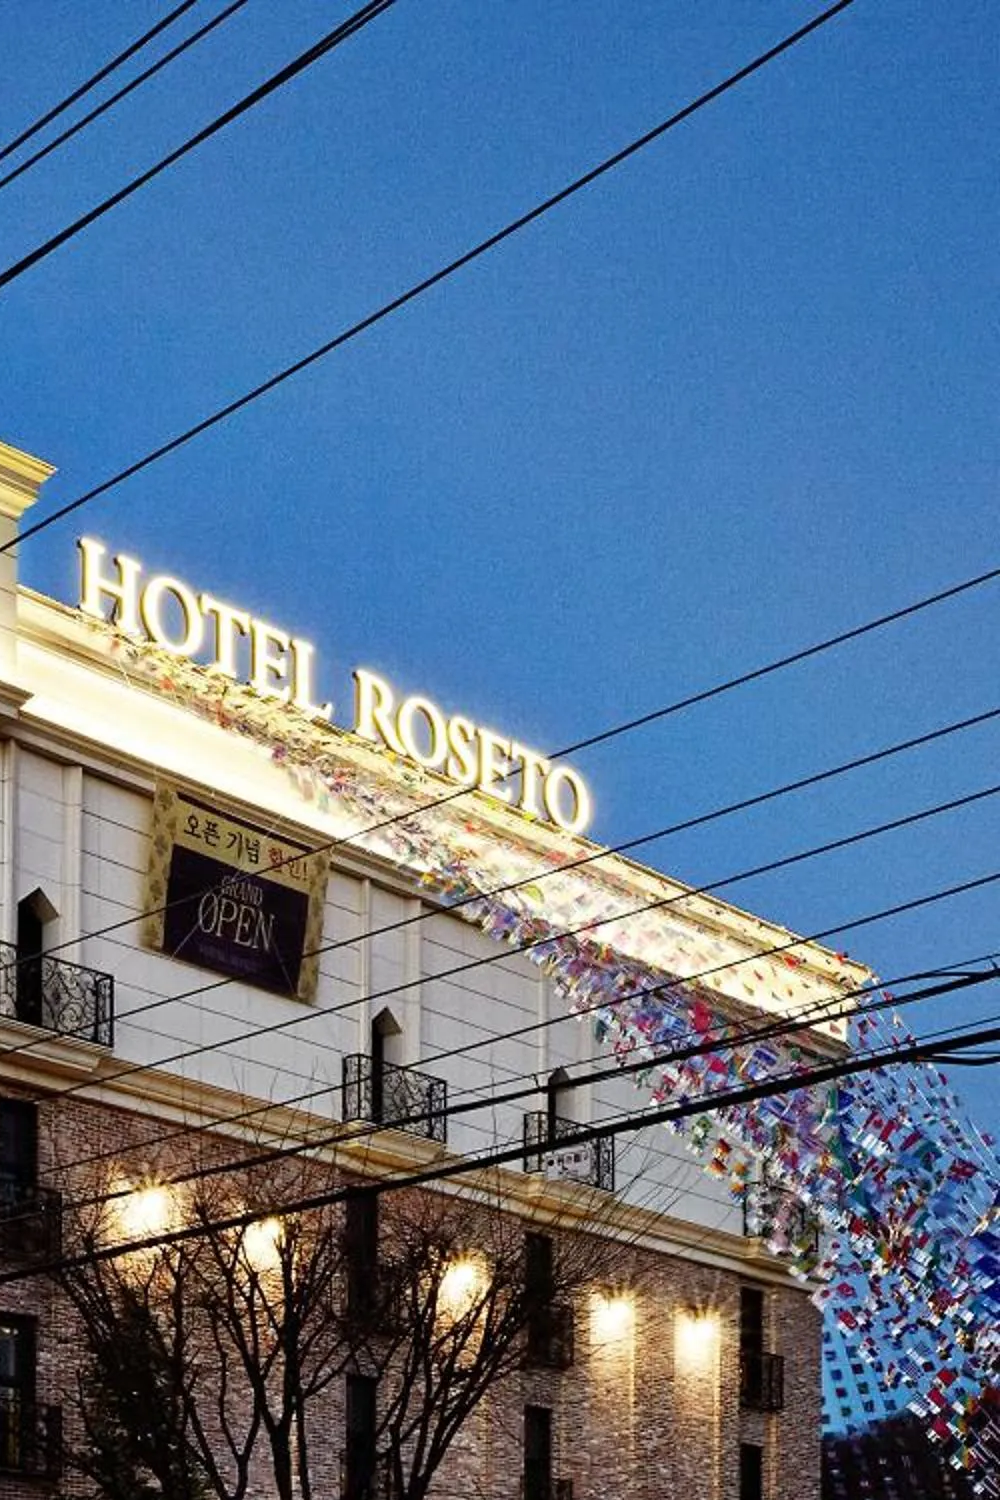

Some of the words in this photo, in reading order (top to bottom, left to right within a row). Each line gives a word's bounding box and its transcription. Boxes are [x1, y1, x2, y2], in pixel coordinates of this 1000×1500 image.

[77, 536, 332, 720] HOTEL
[353, 669, 592, 834] ROSETO
[184, 815, 221, 848] 오픈
[226, 831, 261, 865] 기념
[198, 892, 276, 950] OPEN
